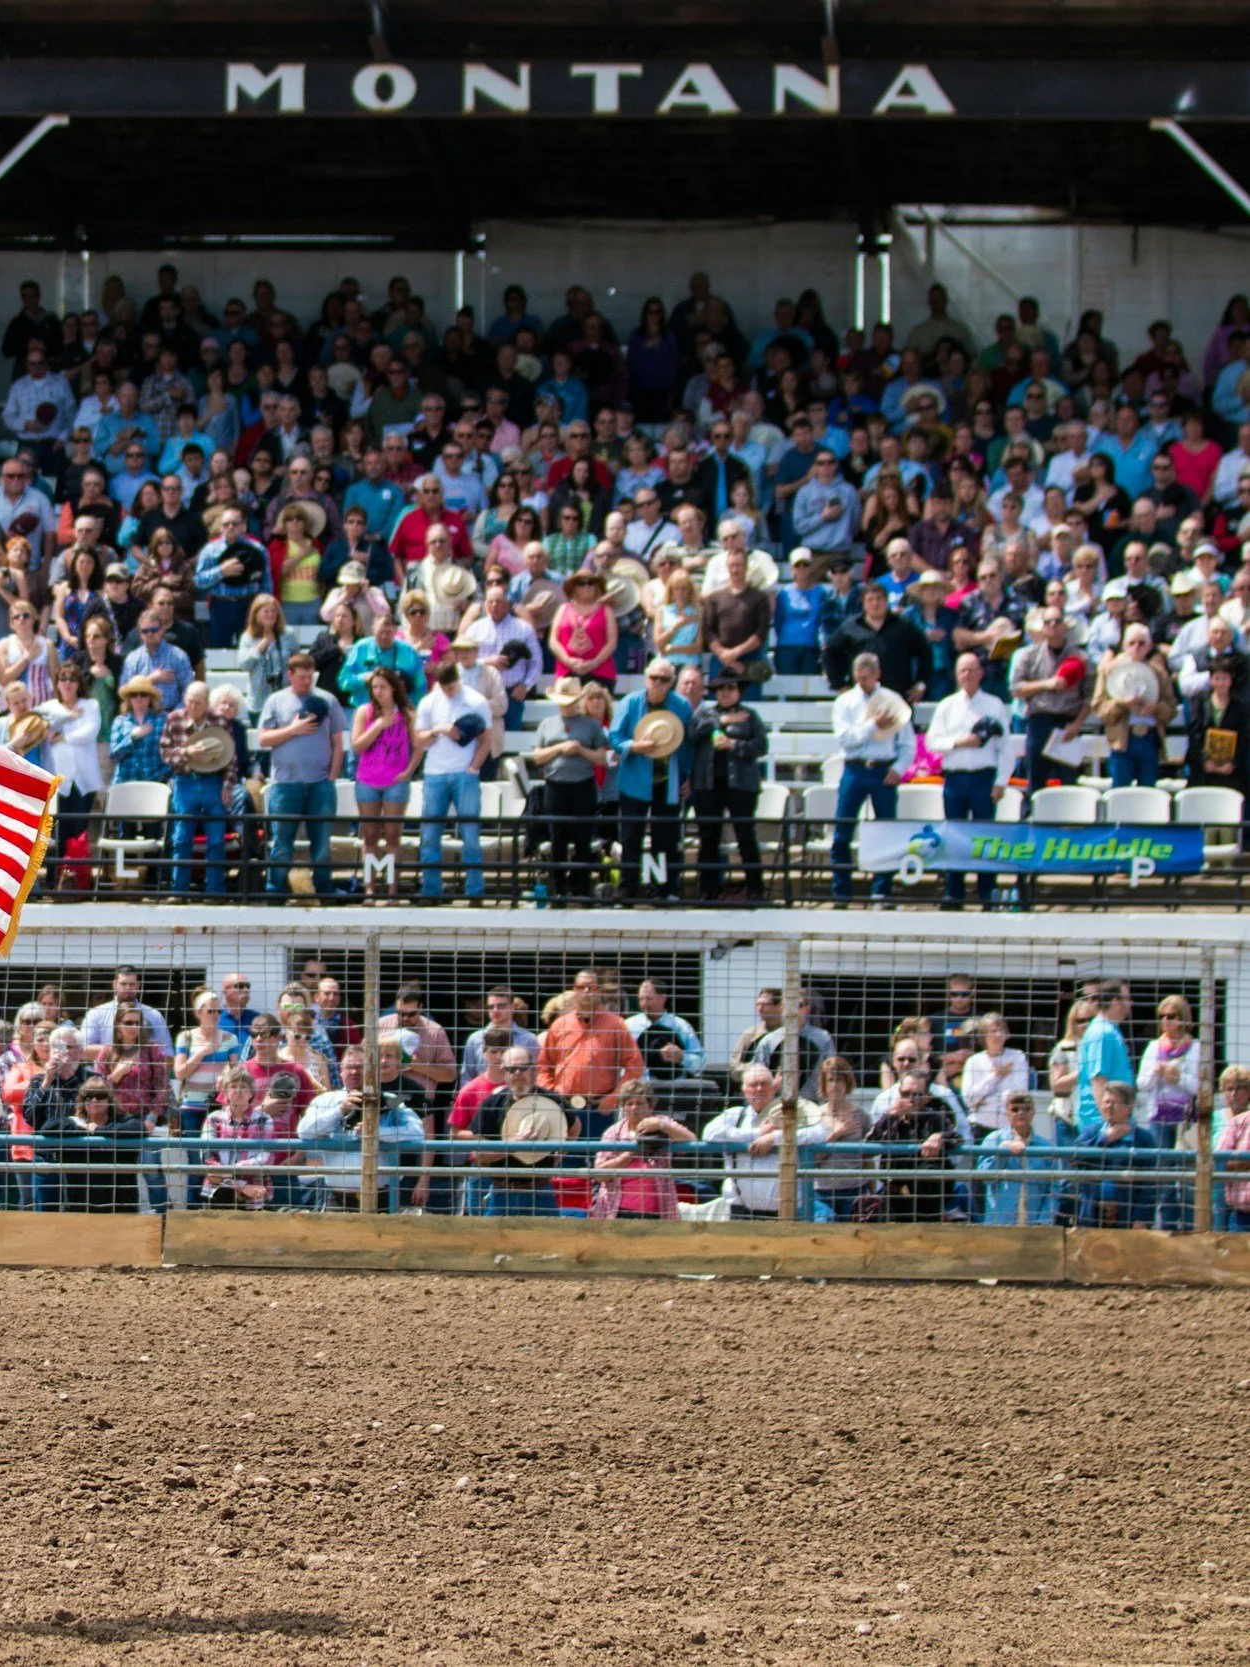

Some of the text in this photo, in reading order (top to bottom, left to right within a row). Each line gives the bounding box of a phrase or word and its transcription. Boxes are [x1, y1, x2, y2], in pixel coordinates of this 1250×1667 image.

[227, 63, 955, 113] MONTANA
[116, 847, 139, 878] L
[971, 835, 1173, 860] The Huddle
[363, 853, 396, 885] M
[641, 852, 667, 884] N
[1130, 856, 1156, 888] P
